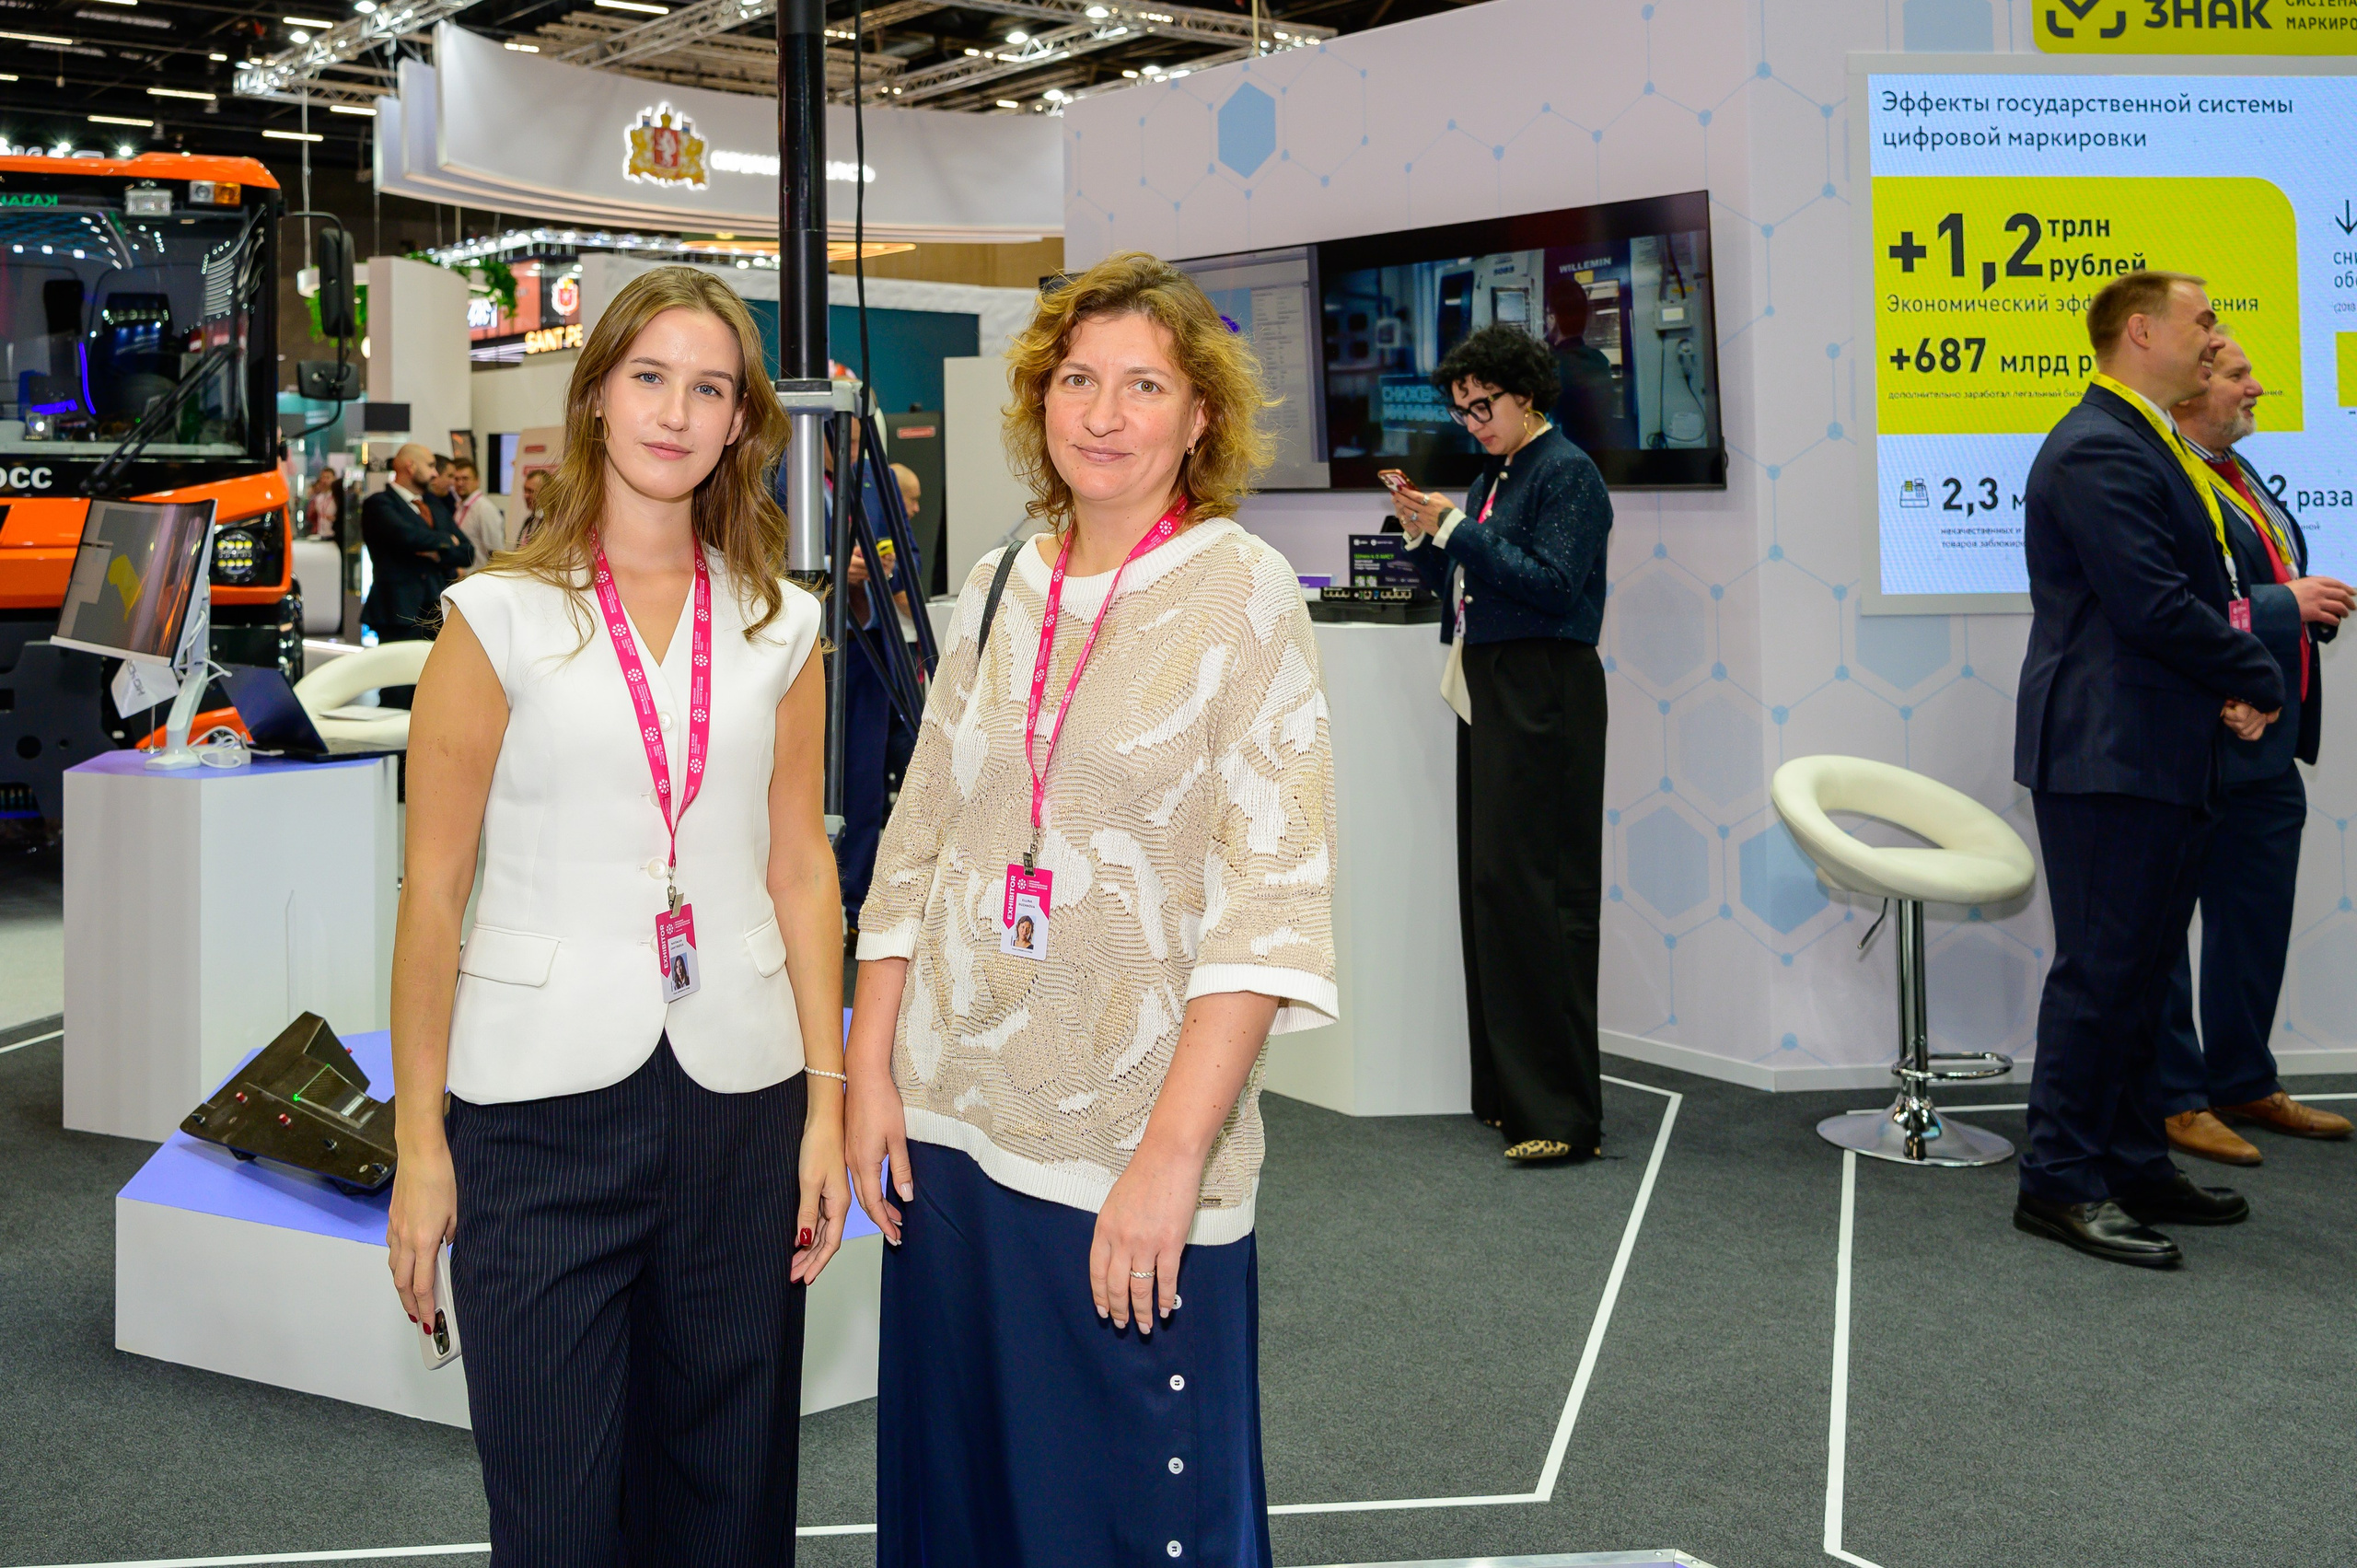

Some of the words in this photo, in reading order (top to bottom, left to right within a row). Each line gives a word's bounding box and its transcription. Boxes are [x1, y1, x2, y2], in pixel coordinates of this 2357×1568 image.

[2144, 0, 2273, 29] ЗНАК
[1882, 91, 1989, 117] Эффекты
[1997, 93, 2190, 117] государственной
[2198, 97, 2293, 113] системы
[1883, 125, 2000, 151] цифровой
[2009, 132, 2147, 151] маркировки
[1559, 257, 1612, 274] WILLEMIN
[1889, 213, 2043, 293] +1,2
[2047, 219, 2110, 242] трлн
[2049, 253, 2146, 282] рублей
[2334, 271, 2357, 288] об
[1887, 295, 2048, 312] Экономический
[1890, 337, 1986, 373] +687
[2000, 355, 2069, 378] млрд
[2079, 355, 2096, 378] р
[1942, 477, 1998, 518] 2,3
[2297, 489, 2353, 512] раза
[1007, 875, 1016, 920] EXHIBITOR
[660, 924, 668, 969] EXHIBITOR
